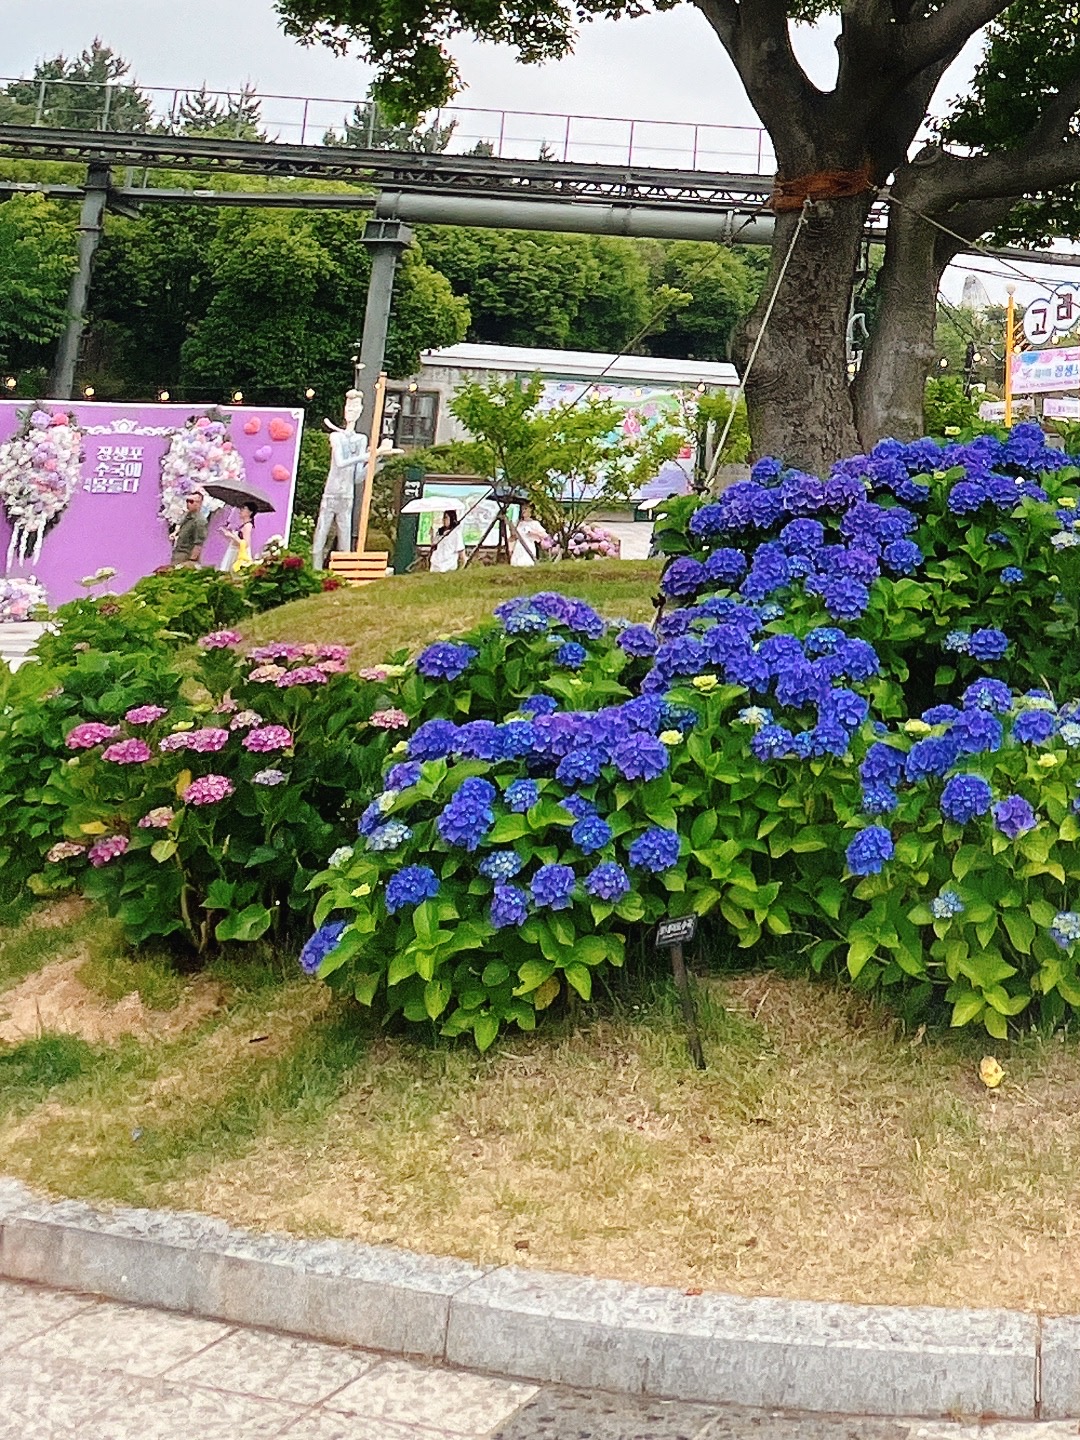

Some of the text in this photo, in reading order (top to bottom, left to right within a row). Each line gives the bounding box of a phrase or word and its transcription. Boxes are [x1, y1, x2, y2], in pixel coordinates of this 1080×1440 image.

[96, 446, 145, 461] 장생포
[93, 462, 143, 478] 수국에
[91, 478, 140, 494] 물들다
